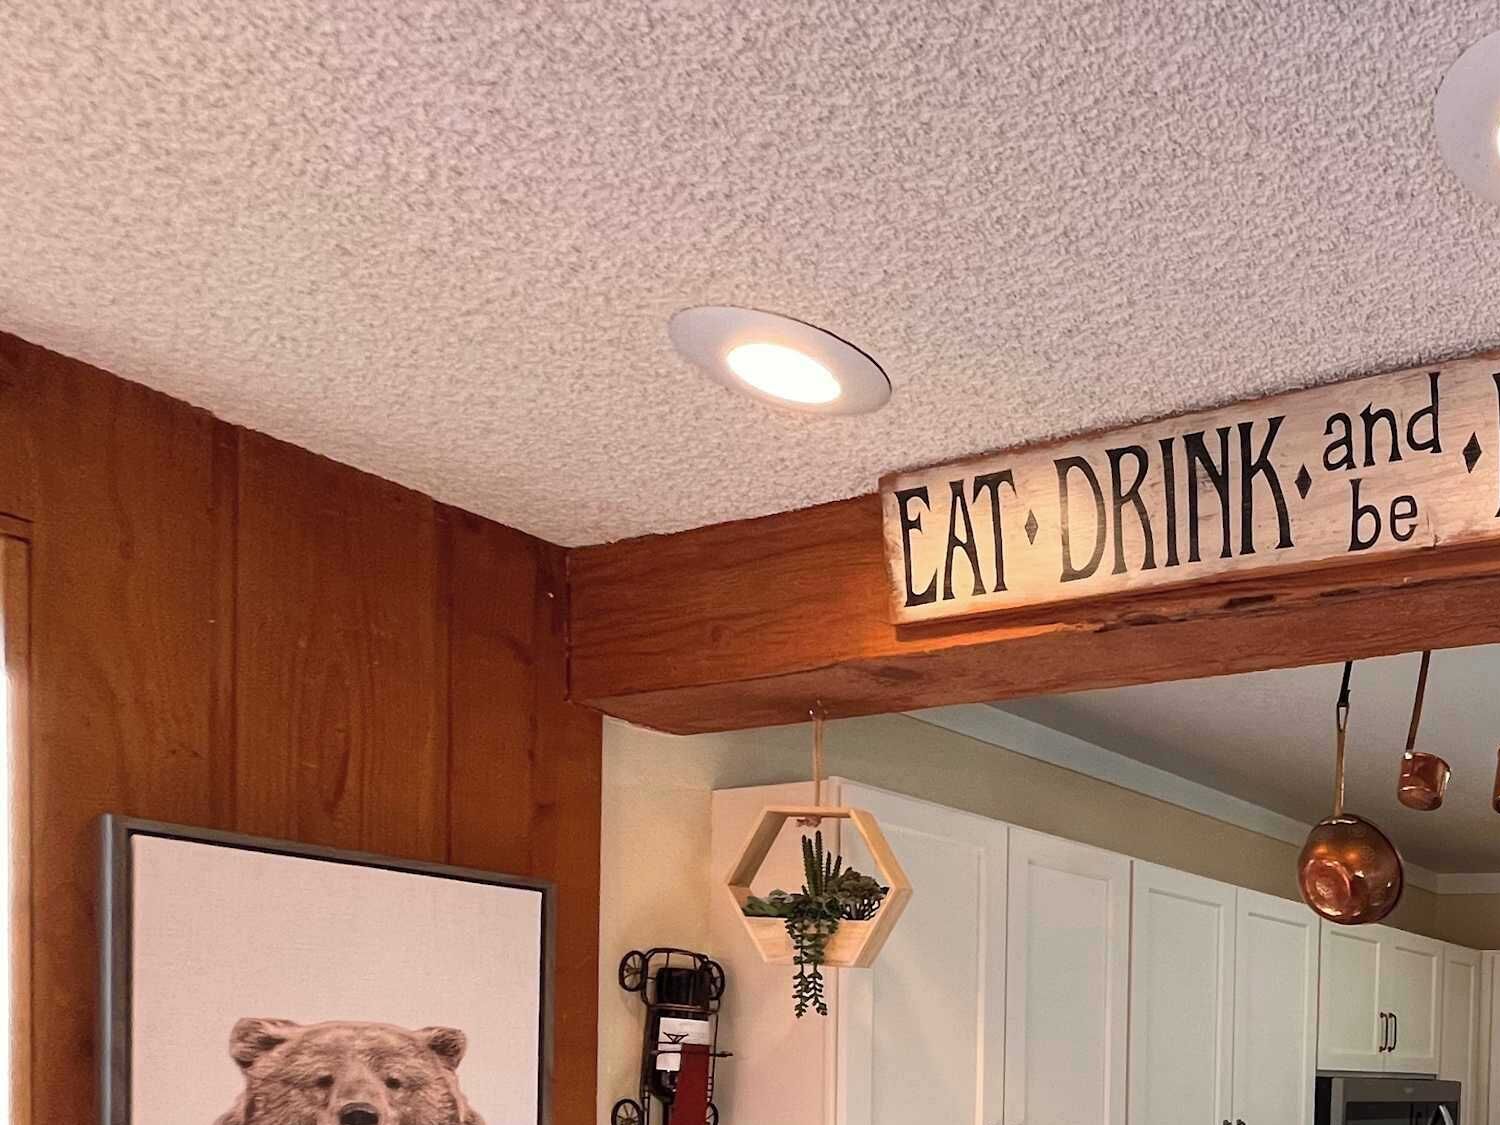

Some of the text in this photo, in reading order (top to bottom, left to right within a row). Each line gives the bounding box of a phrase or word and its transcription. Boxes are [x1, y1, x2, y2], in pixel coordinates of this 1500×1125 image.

[893, 469, 1017, 607] EAT
[1052, 415, 1297, 582] DRINK
[1322, 371, 1443, 472] and
[1348, 478, 1419, 552] be
